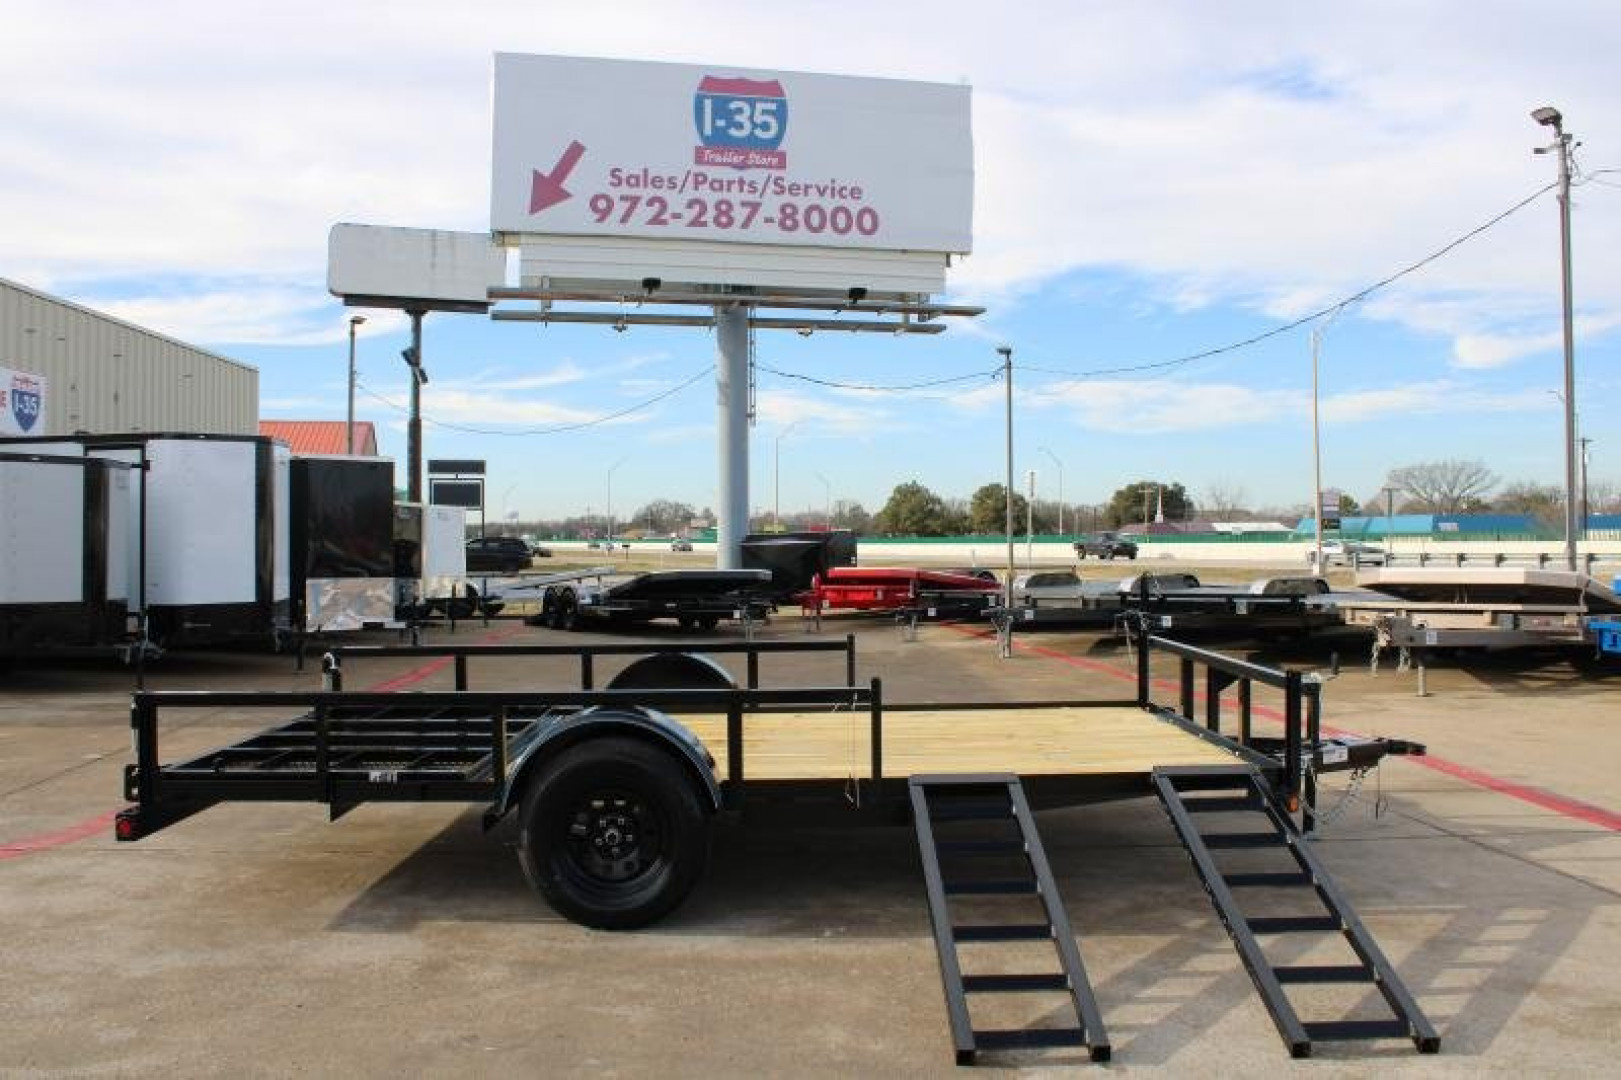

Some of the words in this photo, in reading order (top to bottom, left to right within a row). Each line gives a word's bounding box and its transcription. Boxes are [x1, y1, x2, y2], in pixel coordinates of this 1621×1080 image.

[703, 97, 778, 138] I-35
[703, 149, 745, 163] Trailer
[748, 151, 779, 165] Store
[609, 167, 863, 201] Sales/Parts/Service
[589, 193, 879, 236] 972-287-8000
